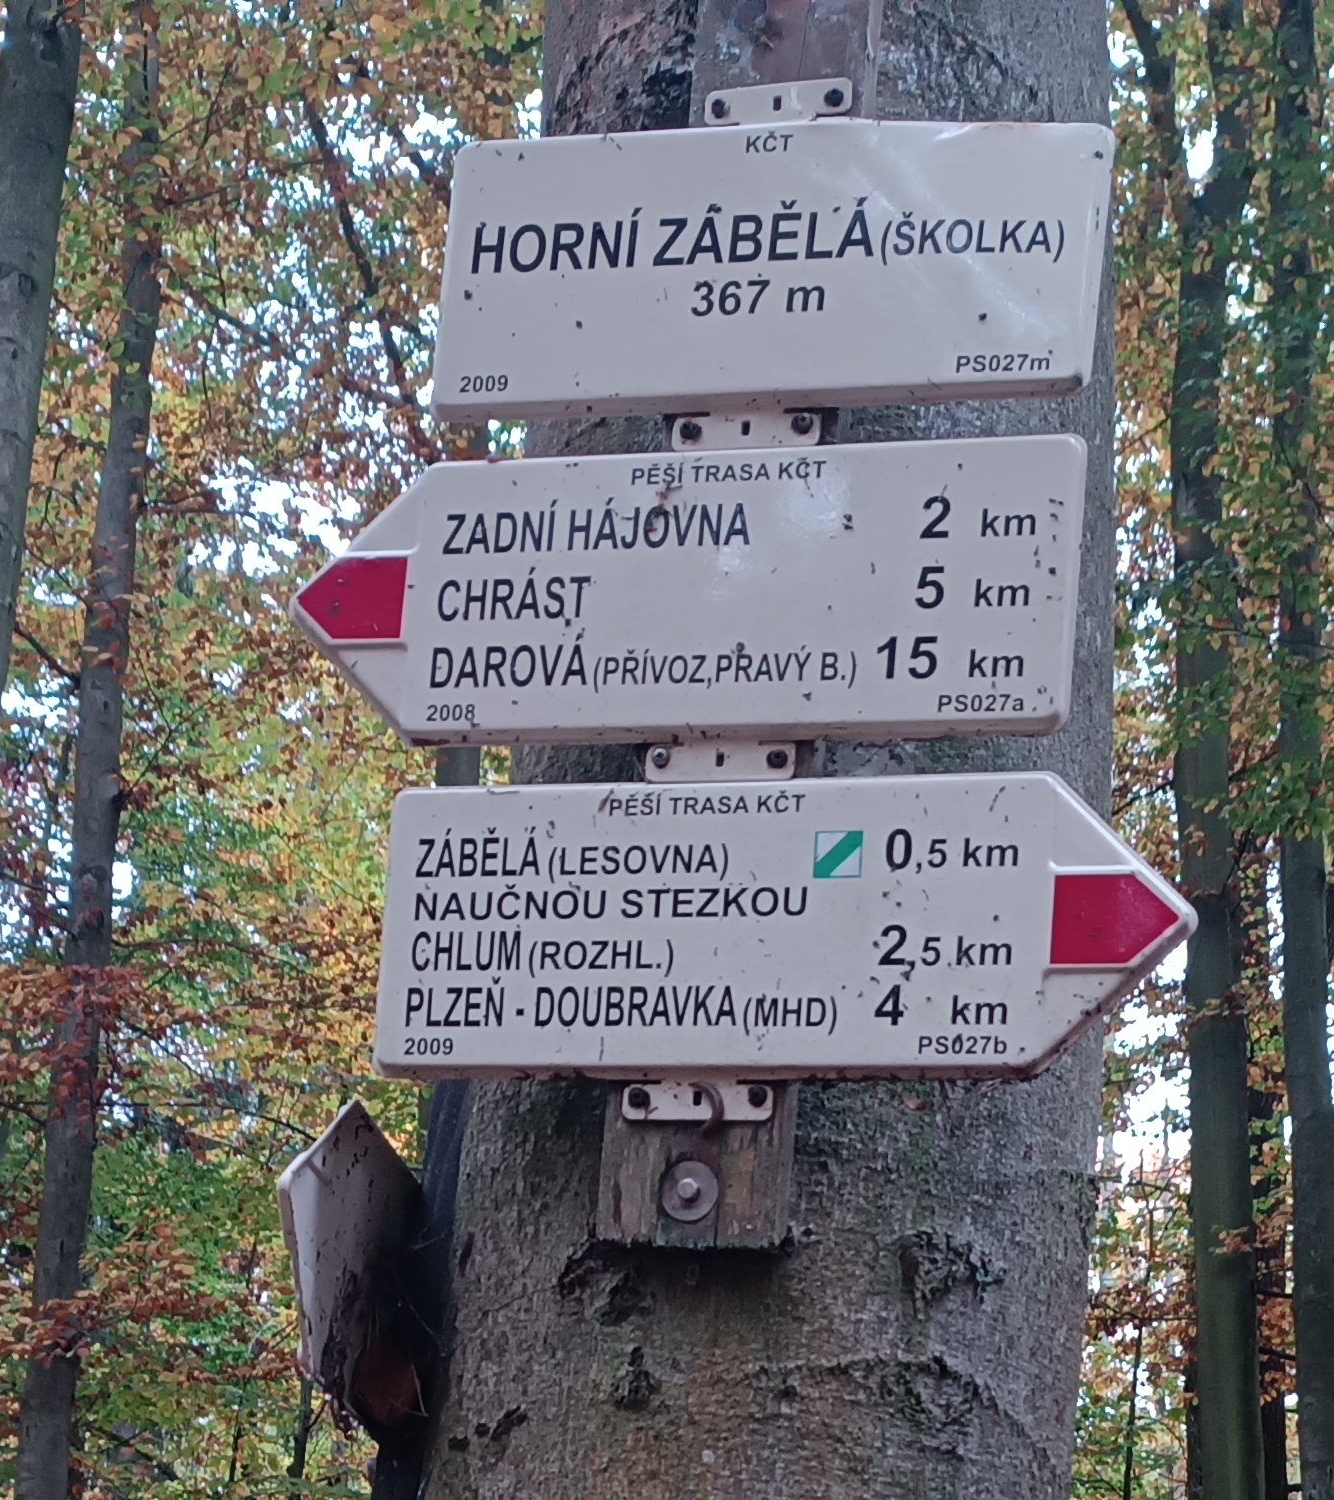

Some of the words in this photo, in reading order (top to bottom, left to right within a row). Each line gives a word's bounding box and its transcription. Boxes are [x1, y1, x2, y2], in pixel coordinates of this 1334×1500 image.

[744, 132, 793, 154] KČT
[469, 206, 642, 274] HORNÍ
[652, 196, 875, 267] ZÁBĚLÁ
[690, 280, 770, 317] 367
[786, 283, 825, 312] m
[459, 375, 509, 393] 2009
[954, 354, 1050, 373] PS027m
[631, 462, 684, 487] PĚŠÍ
[690, 461, 772, 483] TRASA
[778, 459, 827, 481] KČT
[443, 501, 558, 556] ZADNÍ
[566, 498, 751, 550] HÁJOVNA
[919, 496, 952, 539] 2
[980, 509, 1037, 538] km
[436, 567, 593, 622] CHRÁST
[914, 565, 946, 610] 5
[974, 578, 1031, 609] km
[875, 636, 939, 681] 15
[968, 651, 1025, 680] km
[426, 704, 476, 722] 2008
[936, 694, 1026, 714] PS027a
[608, 794, 663, 817] PĚŠÍ
[668, 795, 751, 815] TRASA
[755, 792, 807, 814] KČT
[416, 827, 542, 878] ZÁBĚLÁ
[885, 829, 947, 874] 0,5
[963, 838, 1019, 868] km
[414, 881, 607, 921] NAUČNOU
[620, 886, 809, 919] STEZKOU
[411, 931, 522, 974] CHLUM
[878, 925, 942, 971] 2,5
[956, 936, 1013, 966] km
[405, 976, 506, 1029] PLZEŇ
[533, 985, 737, 1029] DOUBRAVKA
[874, 985, 905, 1026] 4
[952, 995, 1008, 1026] km
[403, 1038, 454, 1056] 2009
[917, 1036, 1007, 1056] PS027b
